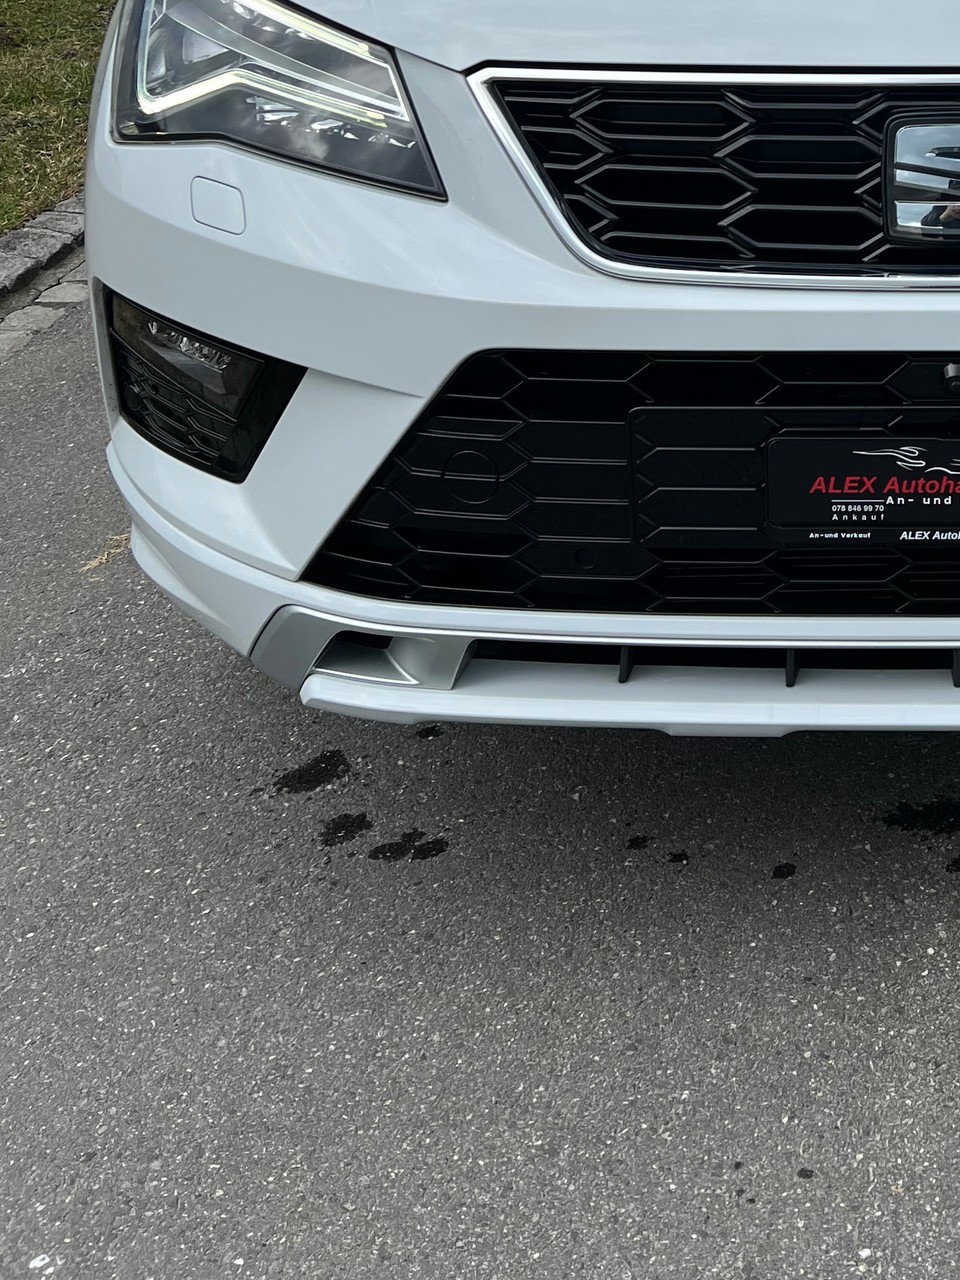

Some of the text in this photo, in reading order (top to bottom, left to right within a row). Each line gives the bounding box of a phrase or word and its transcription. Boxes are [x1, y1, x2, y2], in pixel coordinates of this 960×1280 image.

[809, 476, 878, 494] ALEX
[885, 496, 914, 505] An-
[922, 496, 952, 505] und
[899, 531, 931, 540] ALEX
